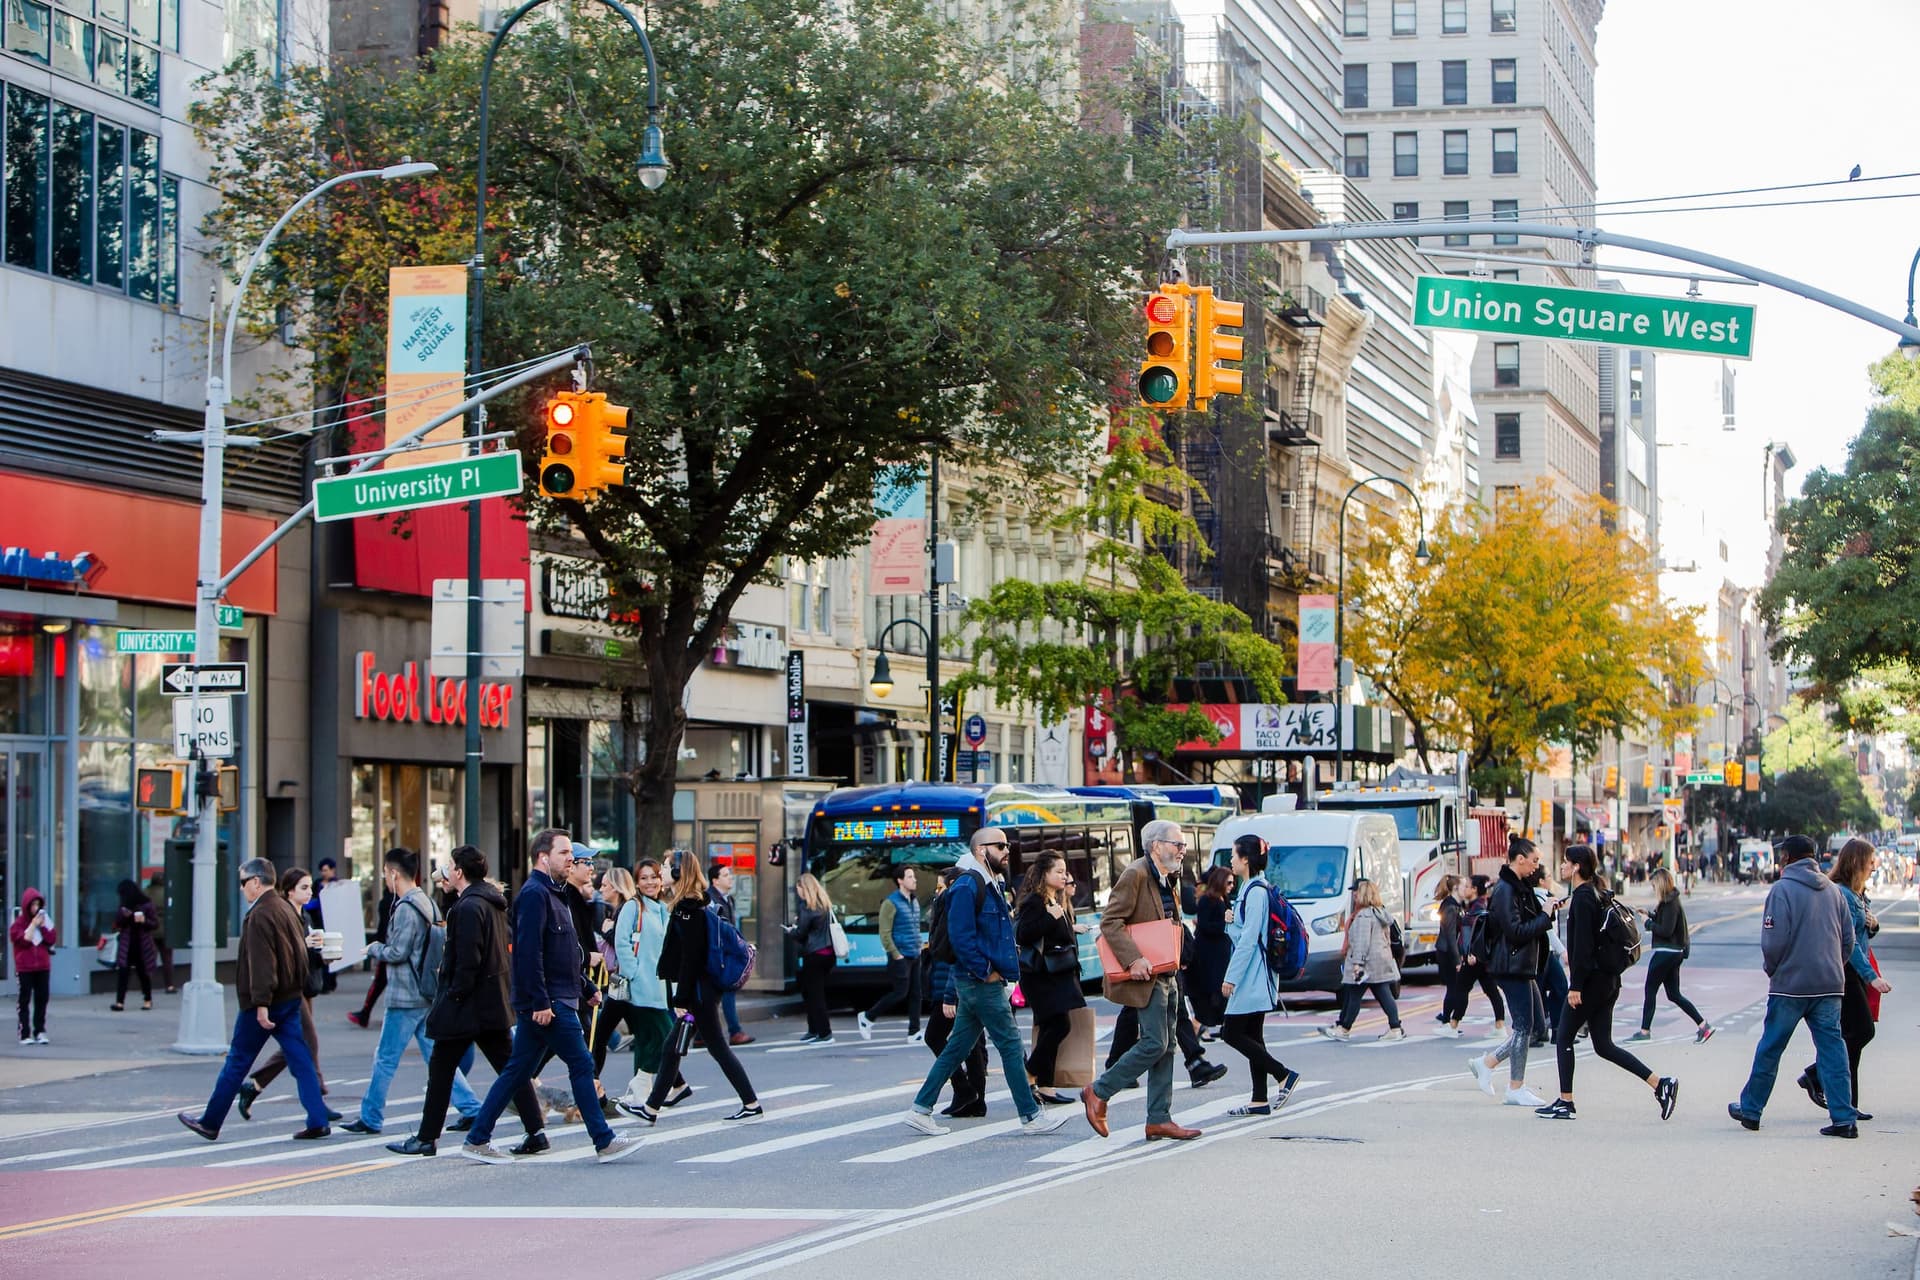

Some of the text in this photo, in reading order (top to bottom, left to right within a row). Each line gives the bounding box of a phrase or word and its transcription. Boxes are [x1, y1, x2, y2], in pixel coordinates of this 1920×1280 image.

[402, 306, 443, 351] HARVEST
[1427, 288, 1740, 344] Union Square West
[417, 322, 455, 362] SQUARE
[354, 467, 480, 504] University Pl
[120, 633, 183, 650] UNIVERSITY
[210, 673, 236, 684] WAY
[359, 651, 421, 722] Foot
[793, 733, 804, 774] LUSH
[1256, 730, 1281, 739] TACO
[1256, 739, 1280, 748] BELL
